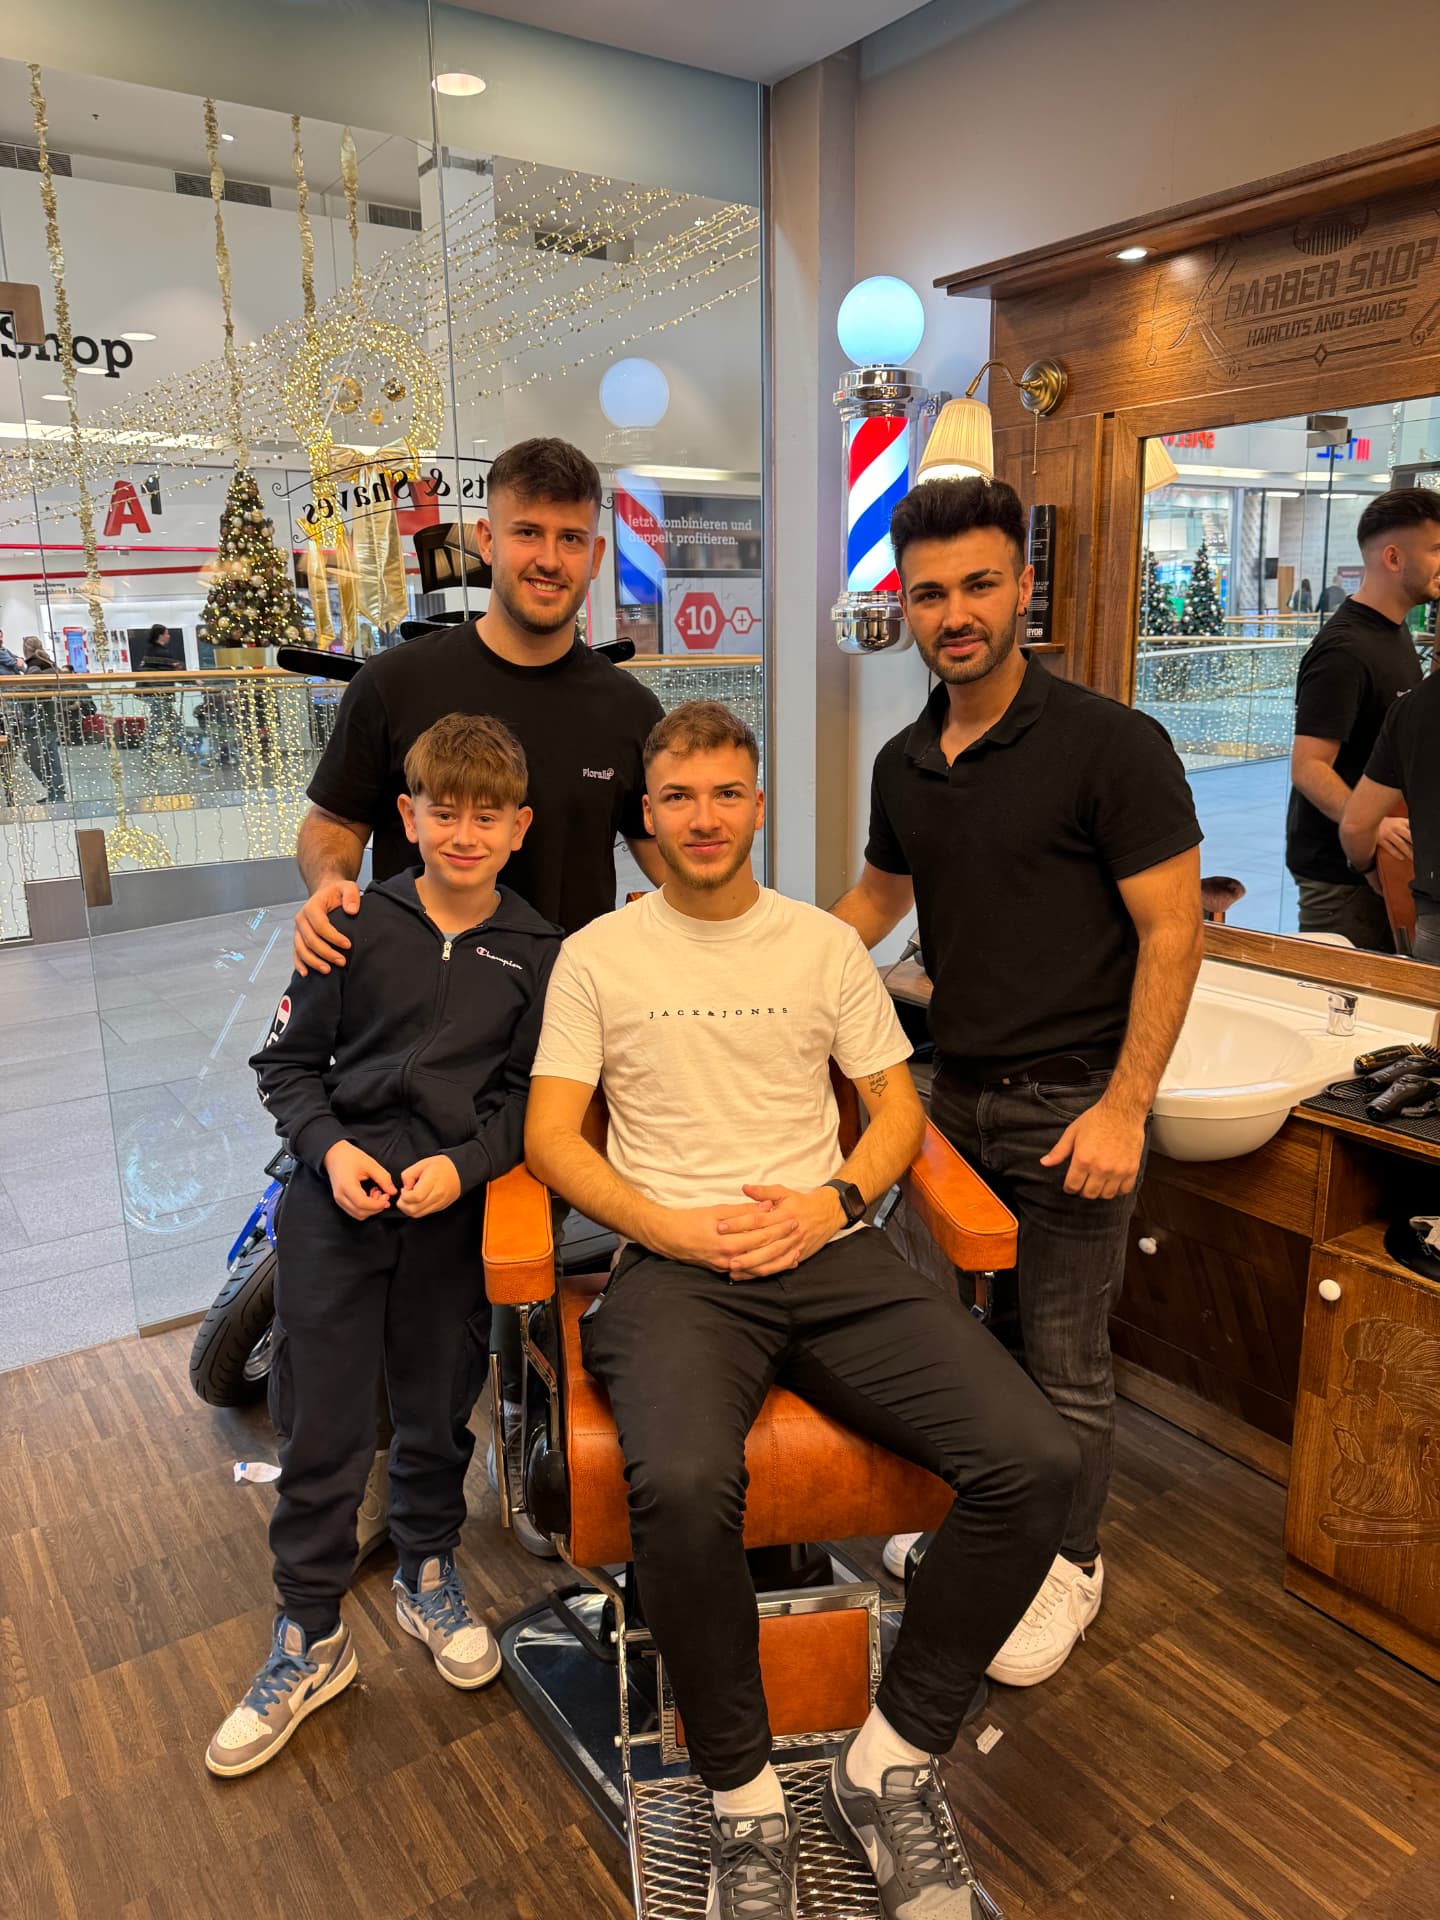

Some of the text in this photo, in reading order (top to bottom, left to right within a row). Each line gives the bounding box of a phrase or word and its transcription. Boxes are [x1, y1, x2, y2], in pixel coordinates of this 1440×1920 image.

[1225, 236, 1440, 321] BARBER SHOP
[1247, 298, 1408, 348] HAIRCUTS AND SHAVES
[627, 514, 752, 531] Jetzt kombinieren und
[628, 532, 739, 546] doppelt profitieren.
[476, 946, 523, 970] Champion
[736, 1819, 755, 1831] NIKE
